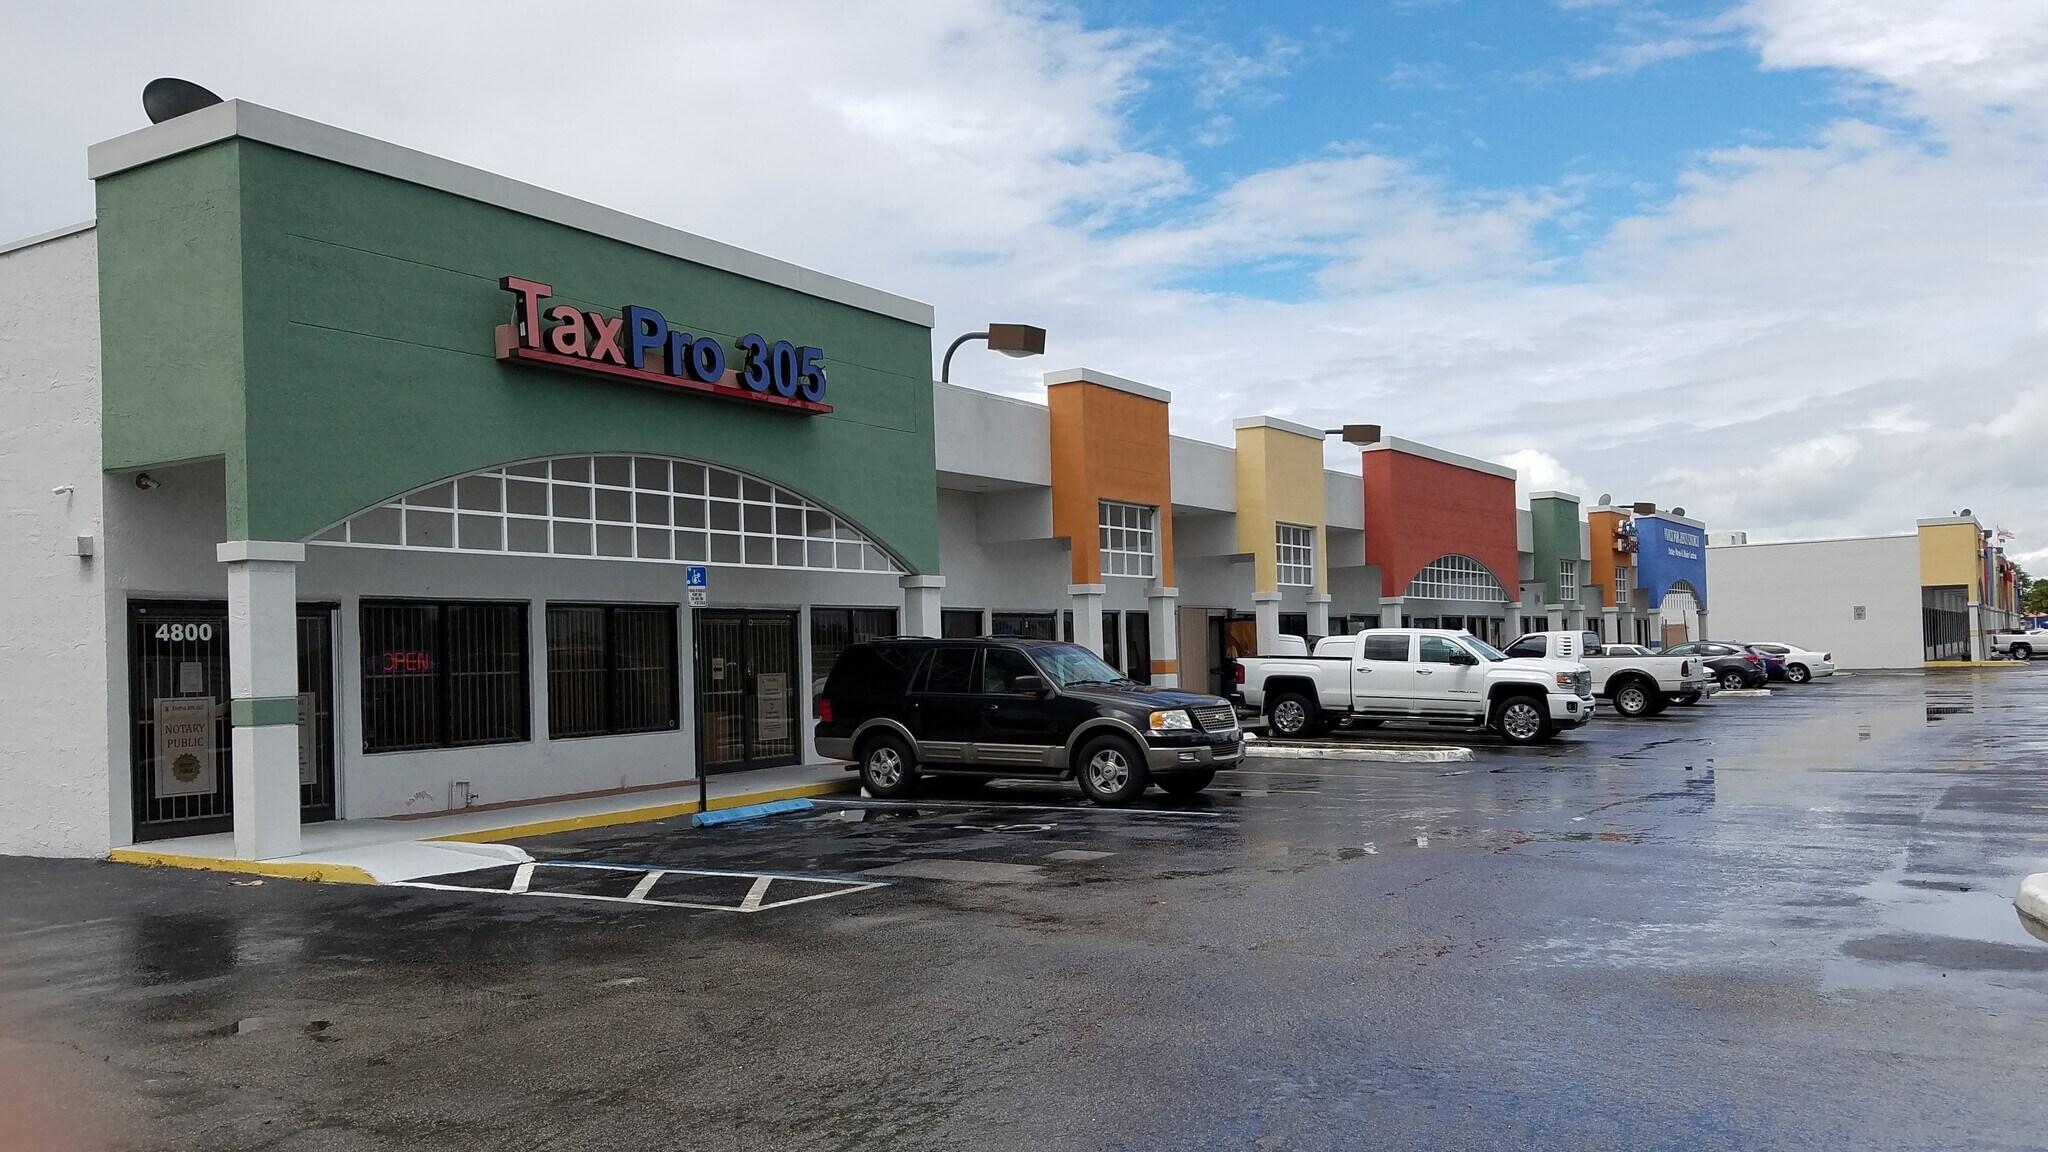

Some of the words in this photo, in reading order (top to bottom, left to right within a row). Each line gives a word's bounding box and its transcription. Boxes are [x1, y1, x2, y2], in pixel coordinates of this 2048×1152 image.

[500, 275, 728, 384] TaxPro
[735, 332, 828, 403] 305
[155, 623, 213, 642] 4800
[383, 652, 430, 671] OPEN
[165, 723, 206, 735] NOTARY
[167, 737, 204, 749] PUBLIC
